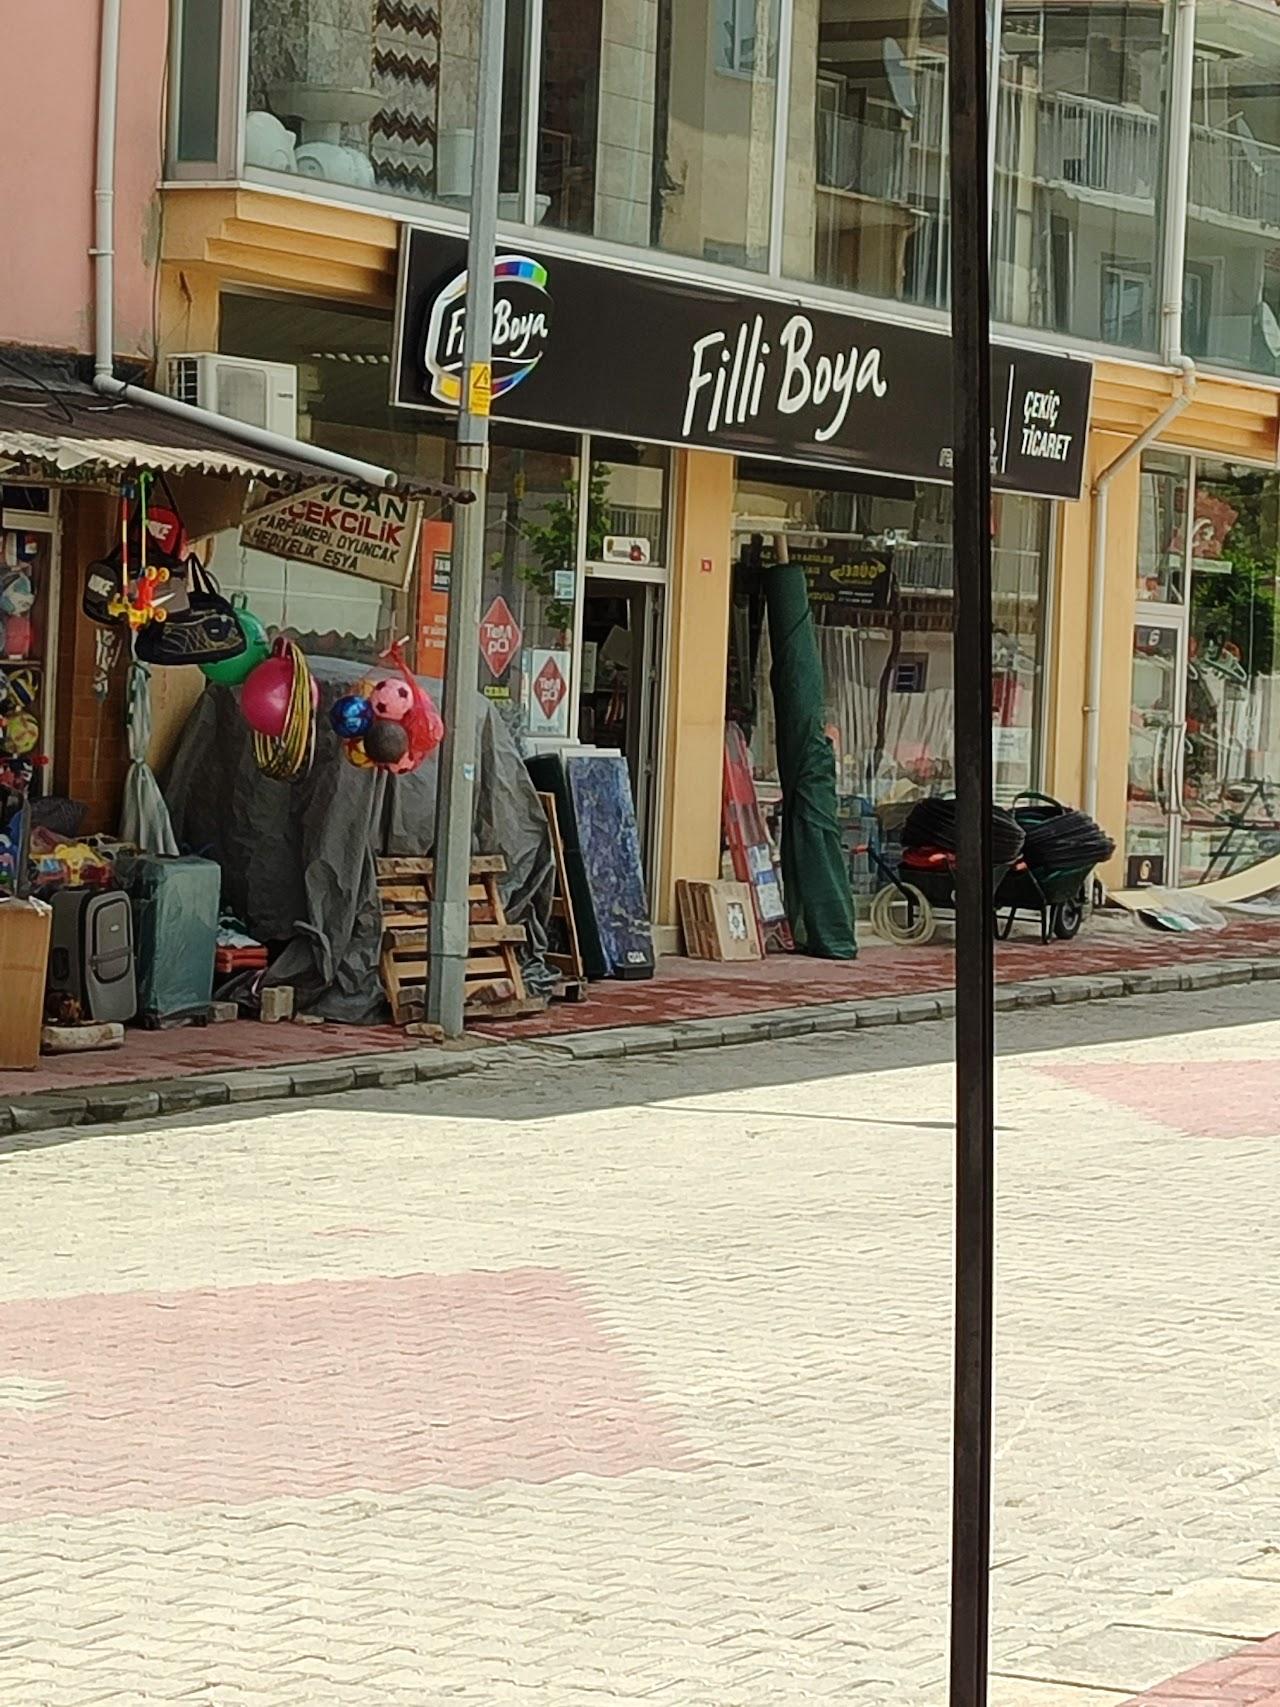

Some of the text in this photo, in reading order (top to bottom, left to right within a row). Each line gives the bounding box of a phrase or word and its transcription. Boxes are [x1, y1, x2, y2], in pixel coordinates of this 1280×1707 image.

[492, 299, 548, 357] Boya
[682, 314, 888, 442] Filli Boya
[1023, 389, 1061, 428] ÇEKİÇ
[1020, 424, 1073, 462] TİCARET
[336, 534, 400, 564] OYUNCAK
